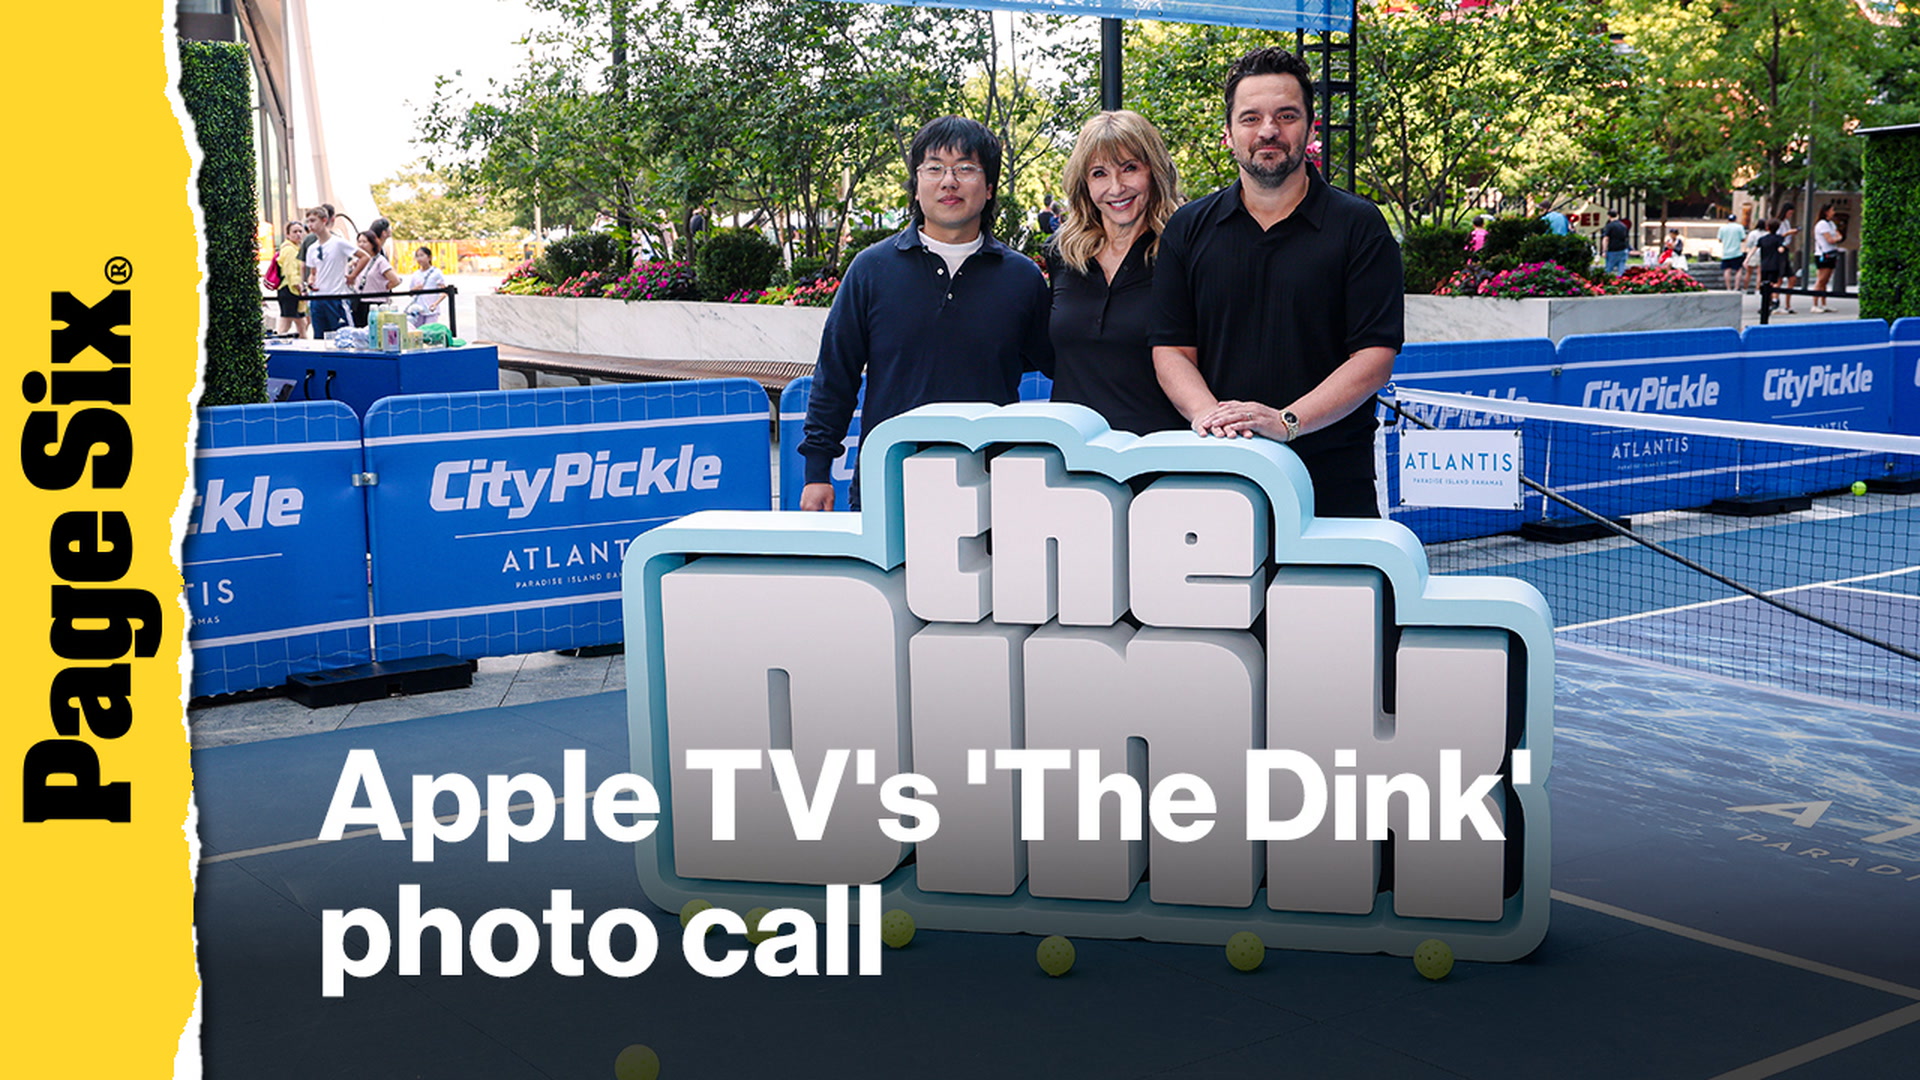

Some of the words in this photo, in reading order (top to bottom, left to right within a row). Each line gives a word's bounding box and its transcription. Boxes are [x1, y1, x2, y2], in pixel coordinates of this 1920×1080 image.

[1582, 373, 1720, 412] CityPickle
[1763, 363, 1874, 408] CityPickle
[1404, 452, 1513, 472] ATLANTIS
[1612, 436, 1689, 459] ATLANTIS
[429, 444, 722, 519] CityPickle
[902, 455, 1258, 630] the
[515, 577, 563, 589] PARADISE
[567, 573, 602, 584] ISLAND
